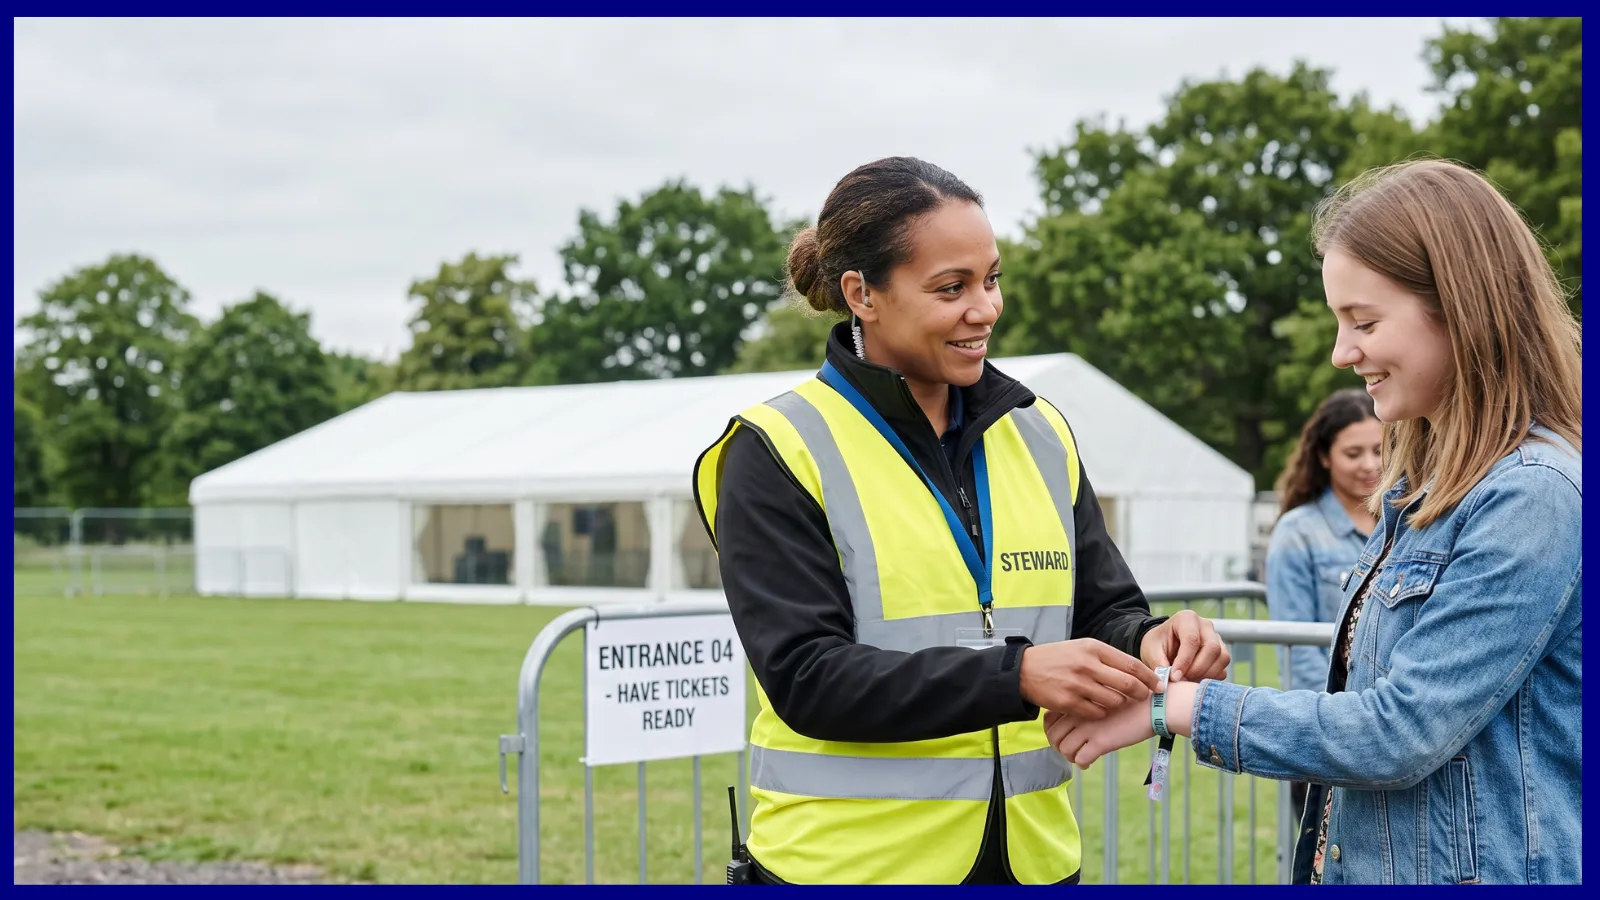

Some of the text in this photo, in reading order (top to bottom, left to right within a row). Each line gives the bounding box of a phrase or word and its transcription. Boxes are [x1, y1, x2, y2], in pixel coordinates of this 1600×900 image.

[1000, 551, 1068, 572] STEWARD
[599, 639, 733, 670] ENTRANCE 04
[618, 681, 660, 703] HAVE
[665, 676, 729, 699] TICKETS
[643, 707, 695, 730] READY
